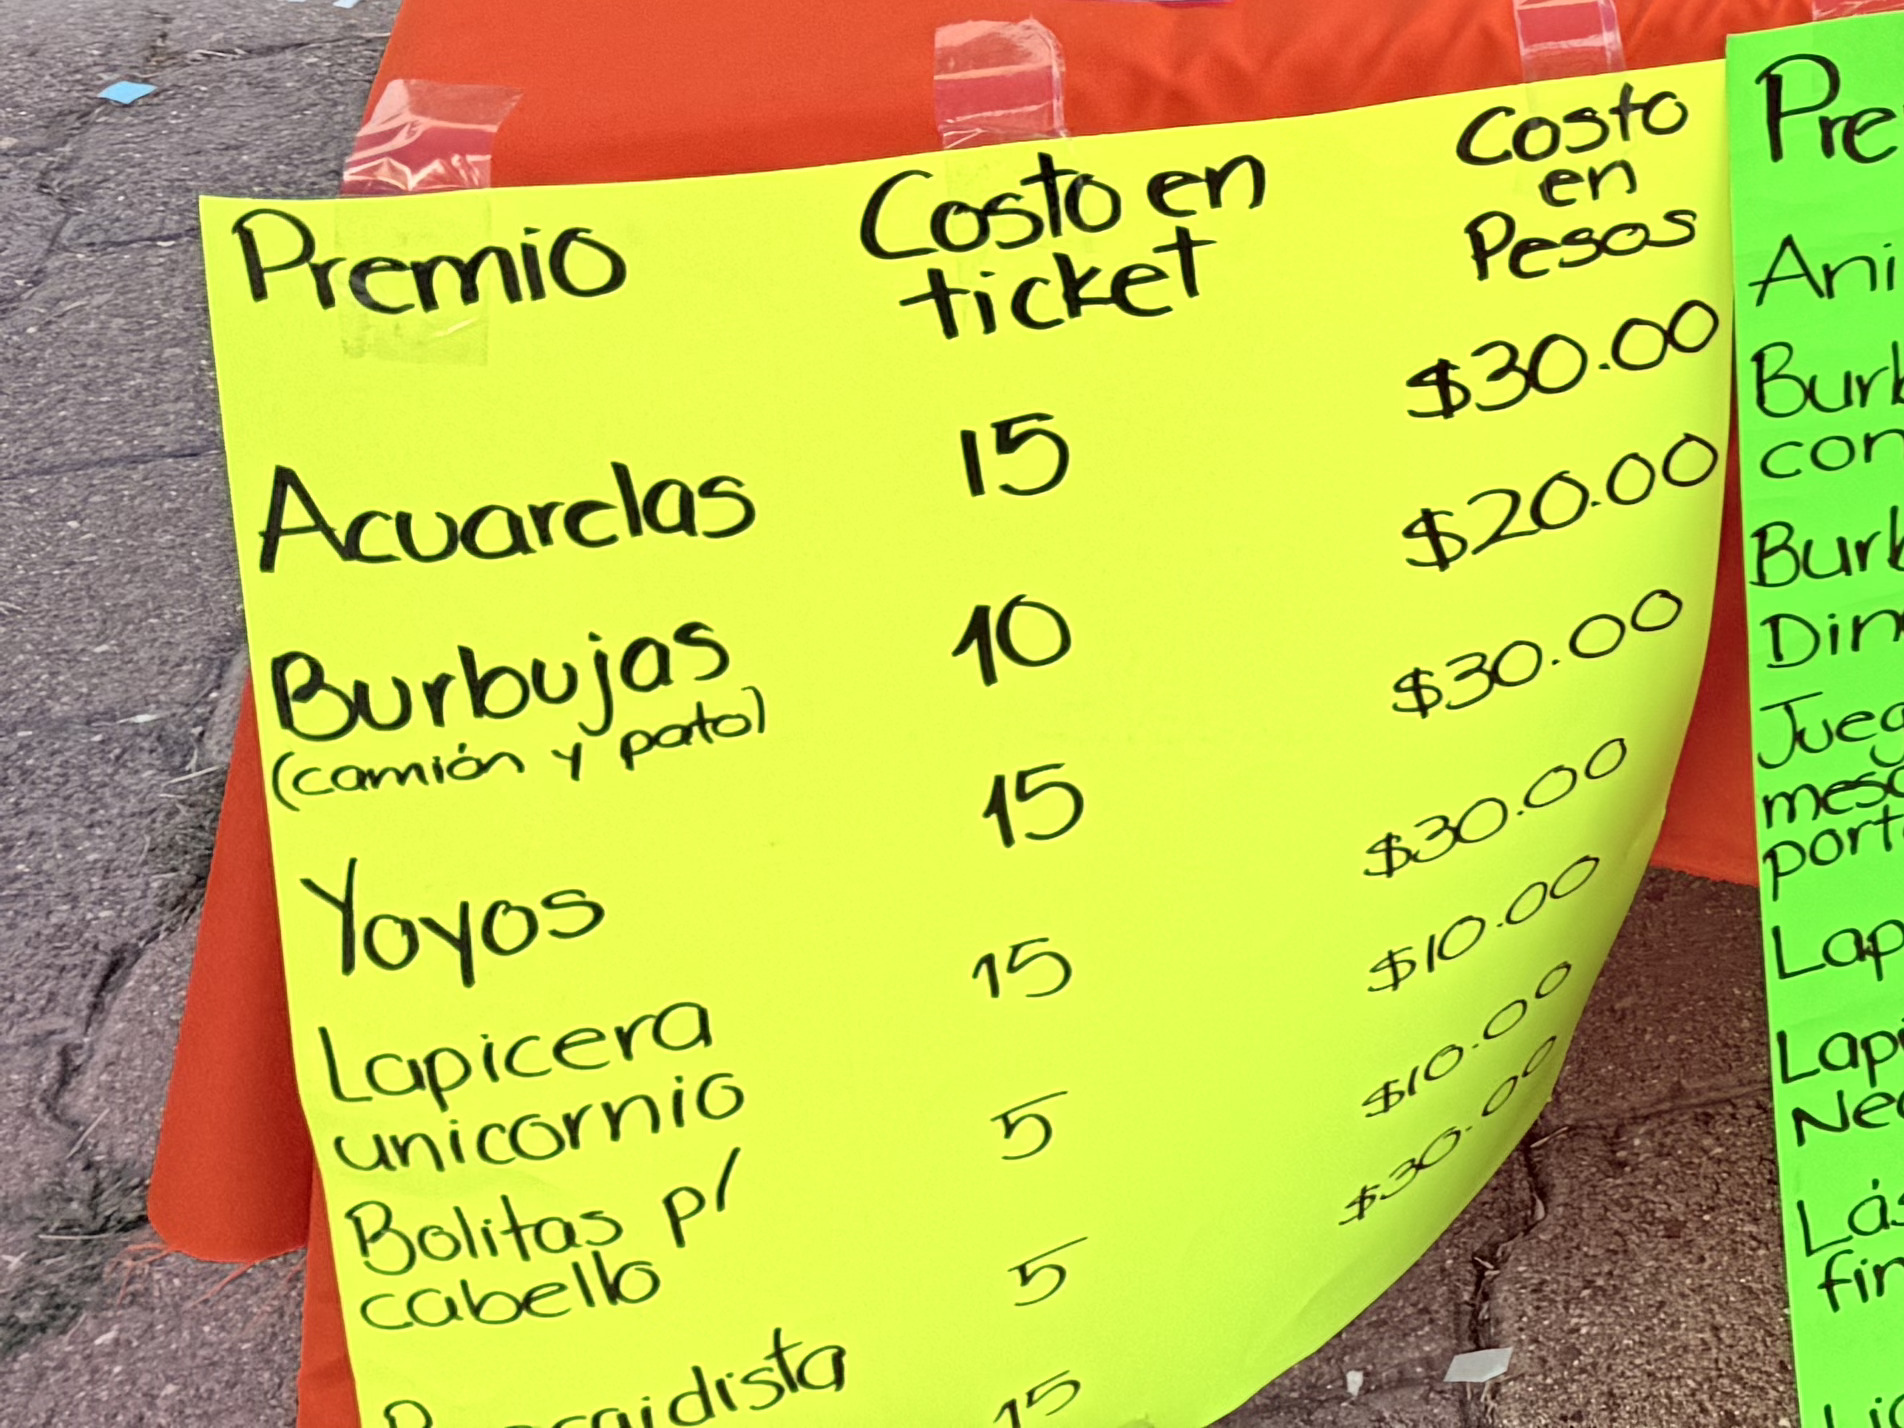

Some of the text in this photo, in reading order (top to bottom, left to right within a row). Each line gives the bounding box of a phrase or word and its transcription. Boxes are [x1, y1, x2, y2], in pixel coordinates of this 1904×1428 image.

[1456, 83, 1688, 176] Costo
[232, 209, 626, 314] Premio
[860, 152, 1265, 277] Costo en
[1465, 210, 1696, 281] Pesos
[900, 217, 1211, 339] ticket
[1407, 300, 1719, 419] $30.00
[259, 462, 755, 572] Acuarelas
[1402, 433, 1719, 571] $20.00
[271, 622, 738, 747] Burbujas
[552, 743, 581, 781] y
[301, 858, 604, 988] Yoyos
[319, 1002, 721, 1117] Lapicera
[328, 1067, 744, 1182] unicornio
[345, 1195, 623, 1275] Bolitas
[360, 1250, 660, 1329] cabello
